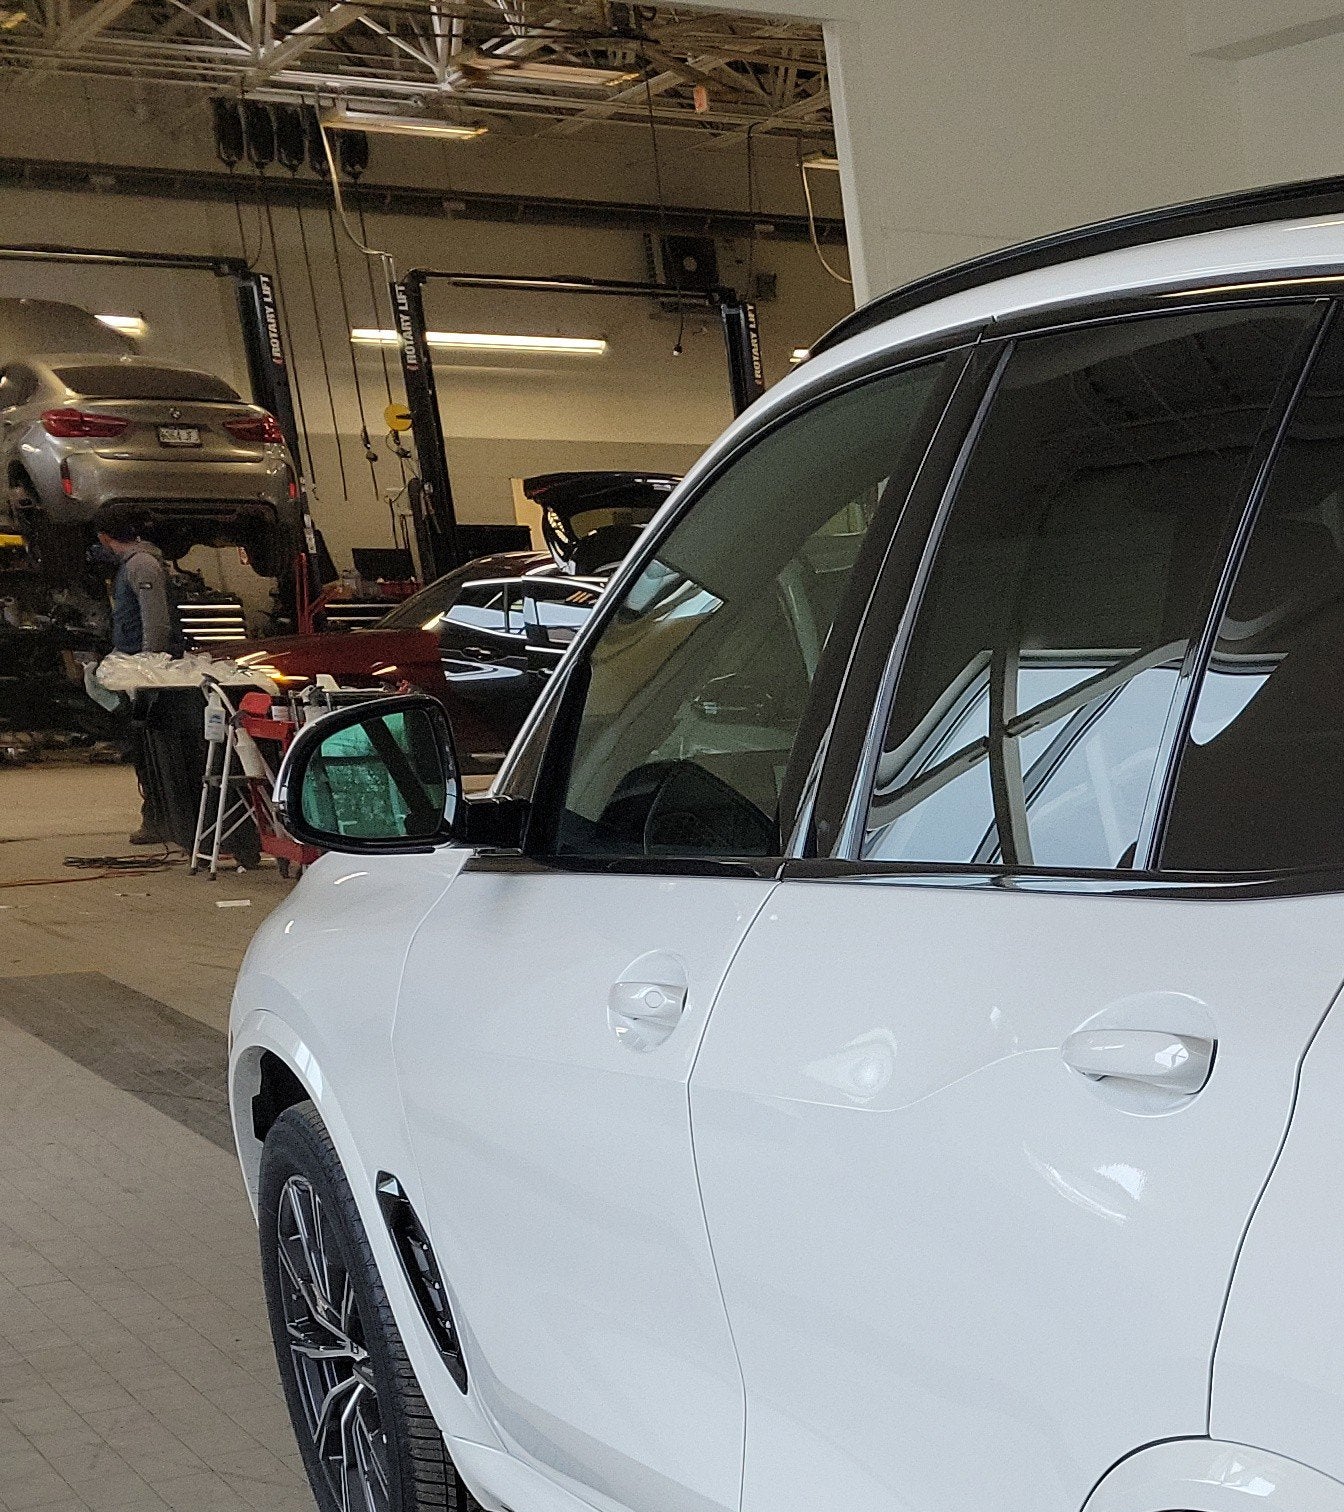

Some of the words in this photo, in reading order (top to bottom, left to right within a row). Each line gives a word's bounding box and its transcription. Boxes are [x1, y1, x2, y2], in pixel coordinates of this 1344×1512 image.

[260, 275, 273, 303] LIFT
[395, 284, 409, 310] LIFT
[265, 305, 281, 357] ROTARY
[400, 314, 417, 364] ROTARY
